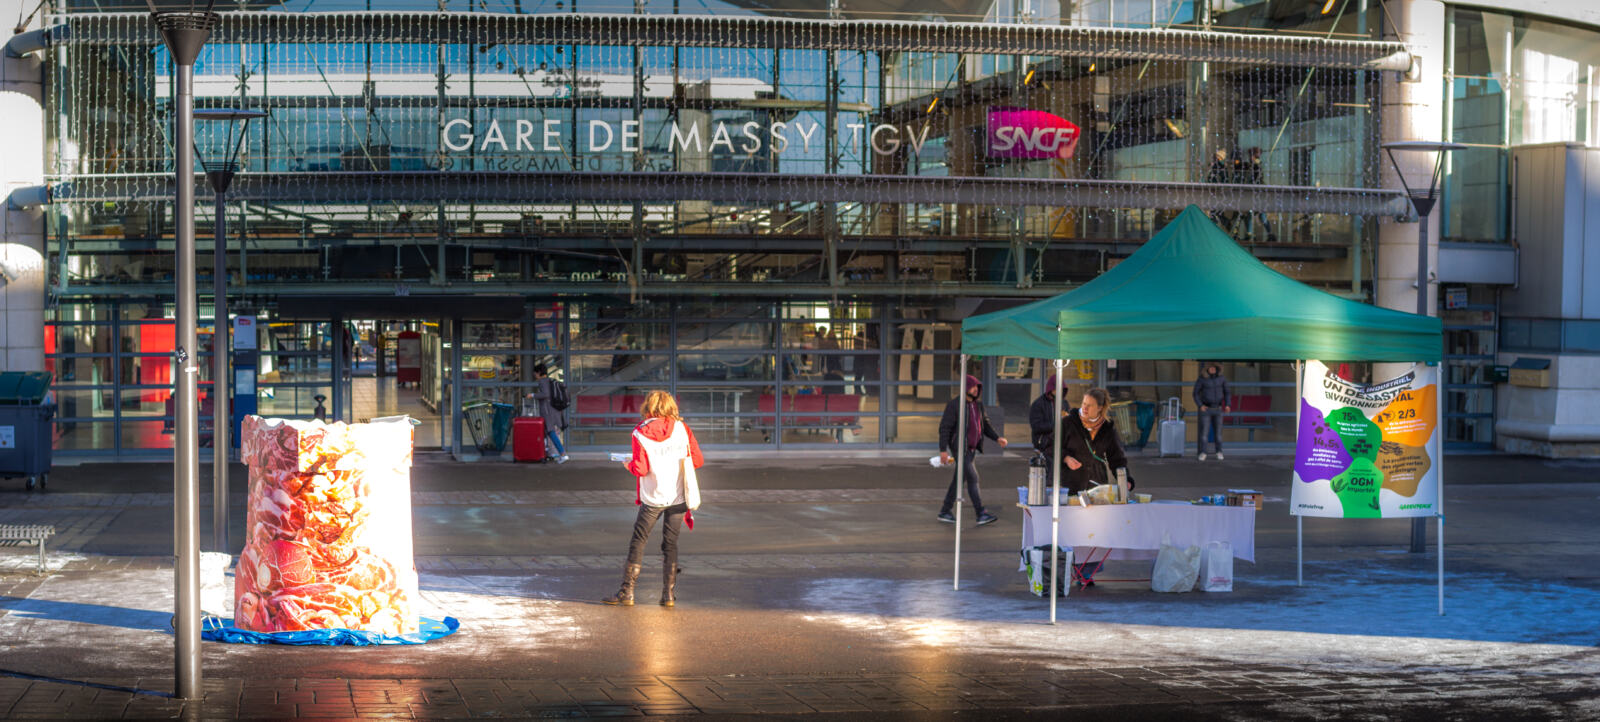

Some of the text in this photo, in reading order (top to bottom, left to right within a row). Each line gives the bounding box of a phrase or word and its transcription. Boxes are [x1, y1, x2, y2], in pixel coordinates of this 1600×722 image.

[442, 118, 931, 158] GARE DE MASSY TGV
[991, 126, 1075, 152] SNCF
[1323, 379, 1342, 393] UN
[1366, 375, 1412, 393] INDUSTRIEL
[1398, 408, 1416, 419] 2/3
[1350, 477, 1374, 487] OGM
